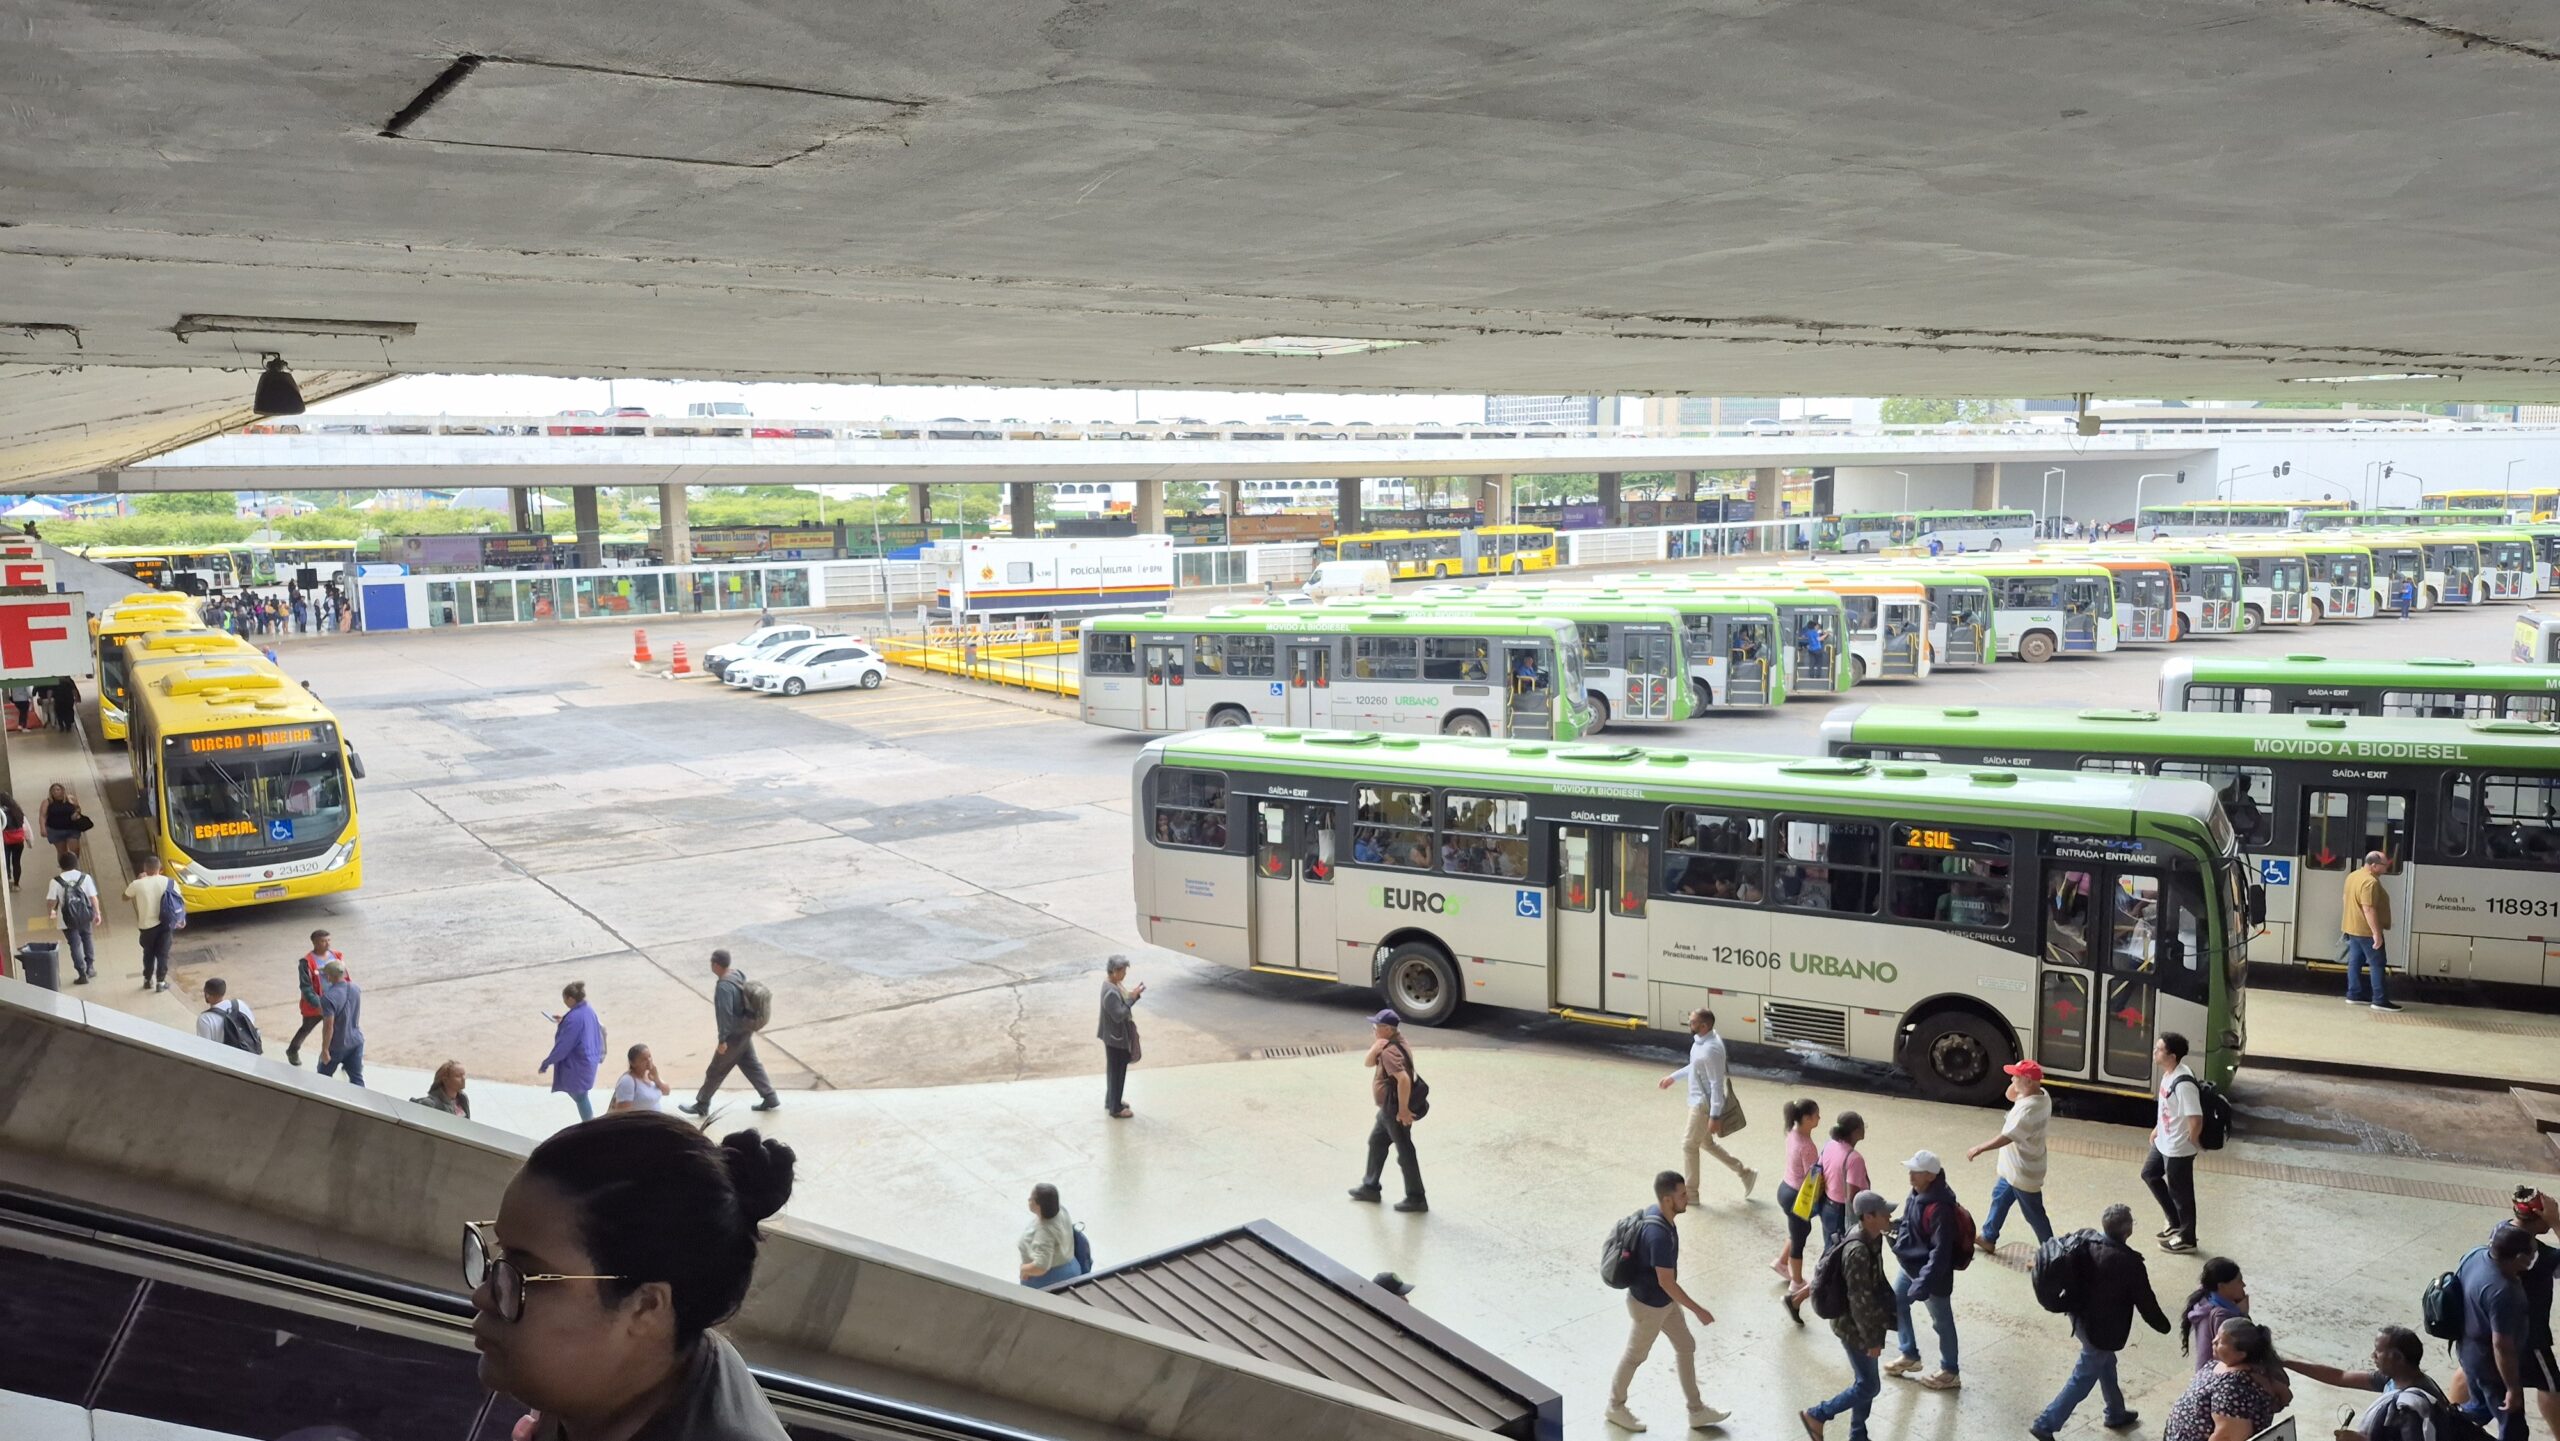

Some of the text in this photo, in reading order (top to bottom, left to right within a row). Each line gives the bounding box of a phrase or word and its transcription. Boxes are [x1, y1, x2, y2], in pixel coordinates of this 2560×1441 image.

[1070, 566, 1133, 575] POLÍCIA MILITAR
[1150, 565, 1162, 573] BPM
[1266, 623, 1298, 631] MOVIDO
[0, 602, 71, 669] F
[2546, 679, 2560, 690] M
[2308, 688, 2329, 696] SAÍDA
[1355, 696, 1388, 705] 120260
[1394, 696, 1439, 706] URBANO
[248, 728, 312, 748] PIONEIRA
[2254, 739, 2469, 760] MOVIDO A BIODIESEL
[1983, 756, 2031, 766] SAÍDA EXIT
[2332, 769, 2388, 779] SAÍDA EXIT
[1268, 786, 1308, 797] SAÍDA EXIT
[1553, 784, 1645, 798] MOVIDO A BIODIESEL
[1571, 810, 1620, 822] SAÍDA EXIT
[195, 821, 258, 839] ESPECIAL
[1924, 831, 1955, 850] SUL
[2056, 848, 2157, 864] ENTRADA ENTRANCE
[280, 862, 319, 876] 234320
[2437, 894, 2458, 903] Área
[2425, 903, 2476, 912] Piracicabana
[2486, 897, 2558, 917] 118931
[1946, 930, 2016, 944] MASCARELLO
[1674, 941, 1691, 951] Área
[1663, 950, 1708, 962] Piracicabana
[1712, 947, 1898, 984] 121606 URBANO
